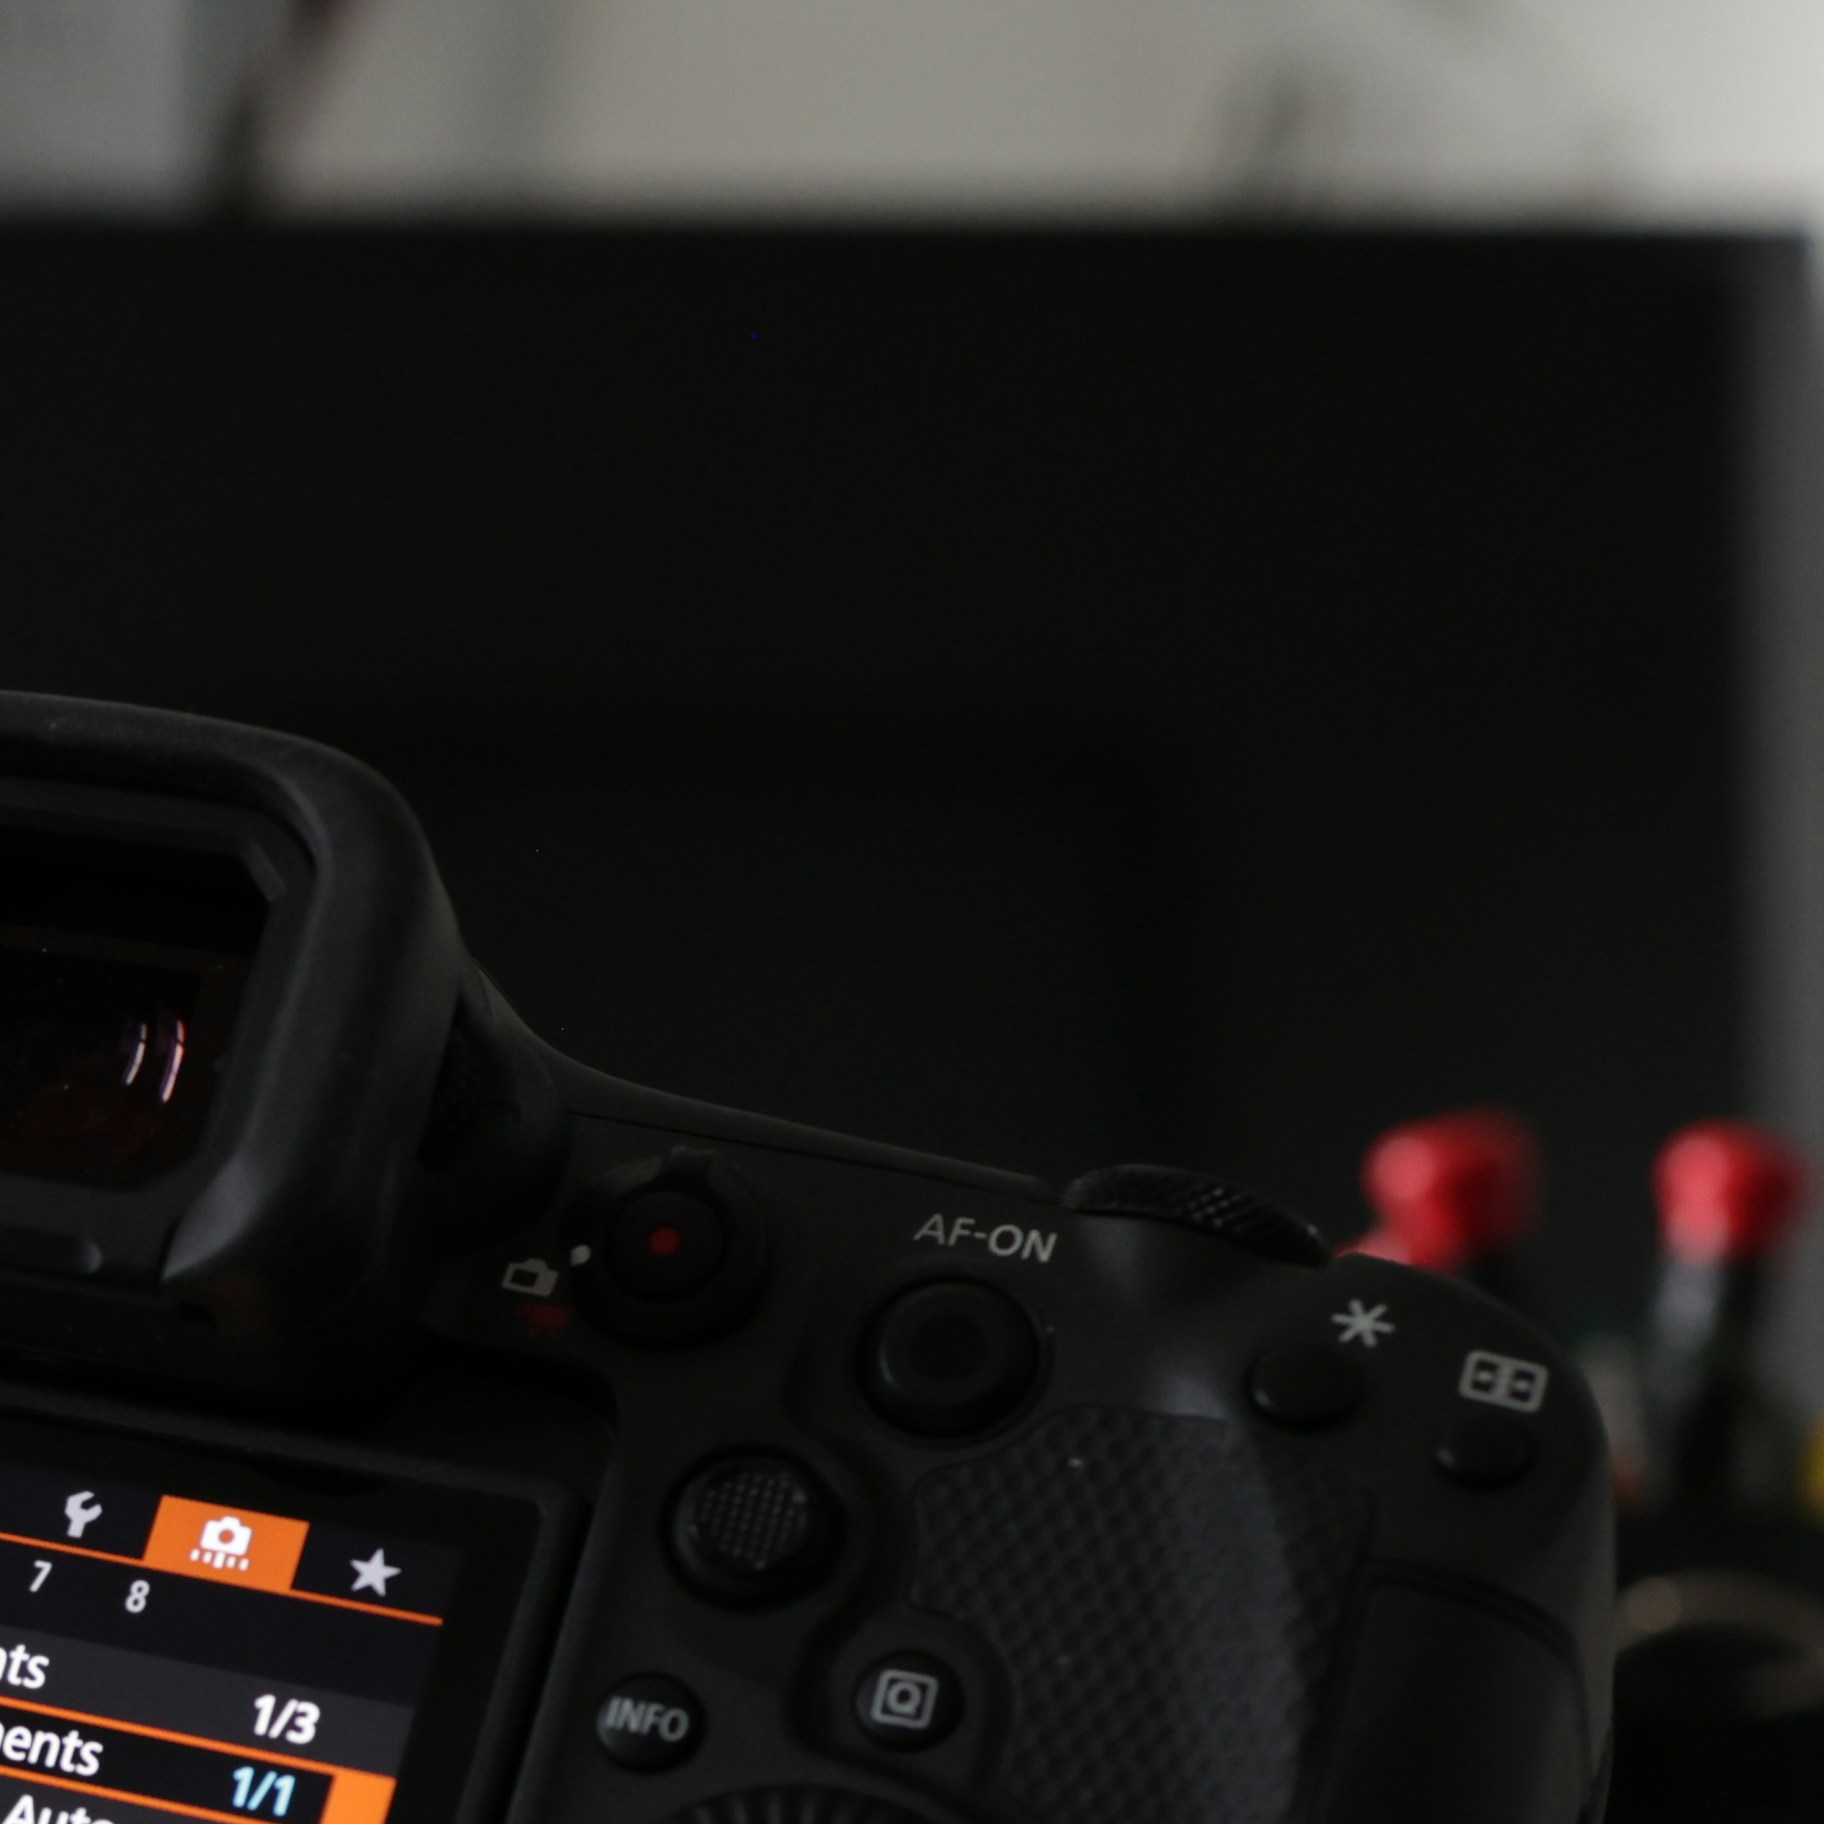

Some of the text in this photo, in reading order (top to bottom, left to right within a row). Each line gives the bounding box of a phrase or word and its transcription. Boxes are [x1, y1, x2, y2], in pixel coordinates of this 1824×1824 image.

[916, 1212, 1057, 1264] AF-ON
[29, 1561, 51, 1593] 7
[125, 1580, 150, 1614] 8
[253, 1694, 321, 1745] 1/3
[604, 1695, 690, 1743] INFO
[232, 1766, 296, 1817] 1/1
